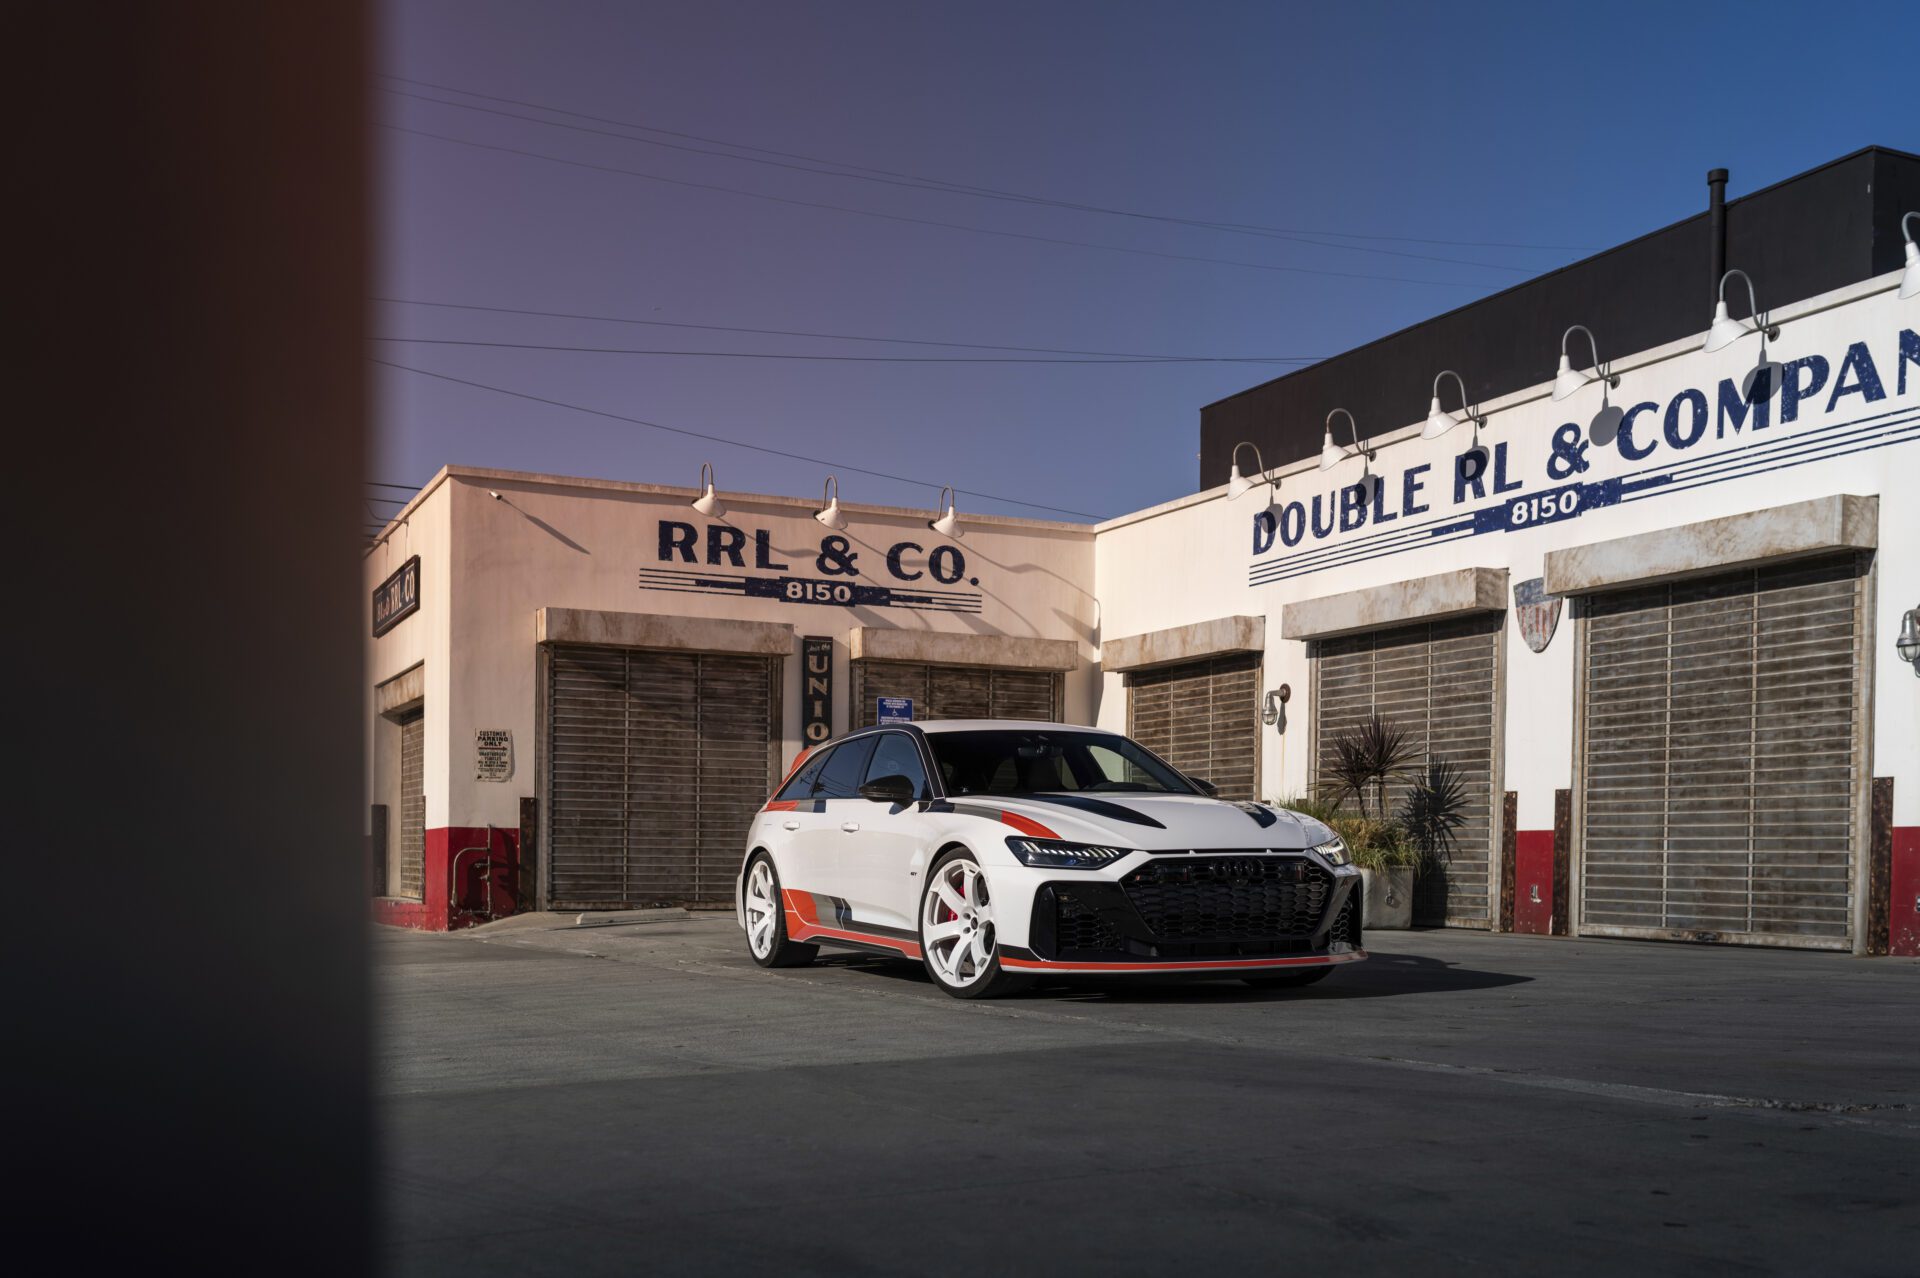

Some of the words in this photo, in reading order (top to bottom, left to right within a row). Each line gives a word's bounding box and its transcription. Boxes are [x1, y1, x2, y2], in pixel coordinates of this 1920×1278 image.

[1252, 462, 1431, 556] DOUBLE
[1453, 440, 1523, 505] RL
[1546, 421, 1590, 481] &
[1511, 489, 1579, 525] 8150
[657, 519, 789, 572] RRL
[815, 534, 860, 577] &
[886, 541, 979, 586] CO.
[785, 581, 851, 603] 8150
